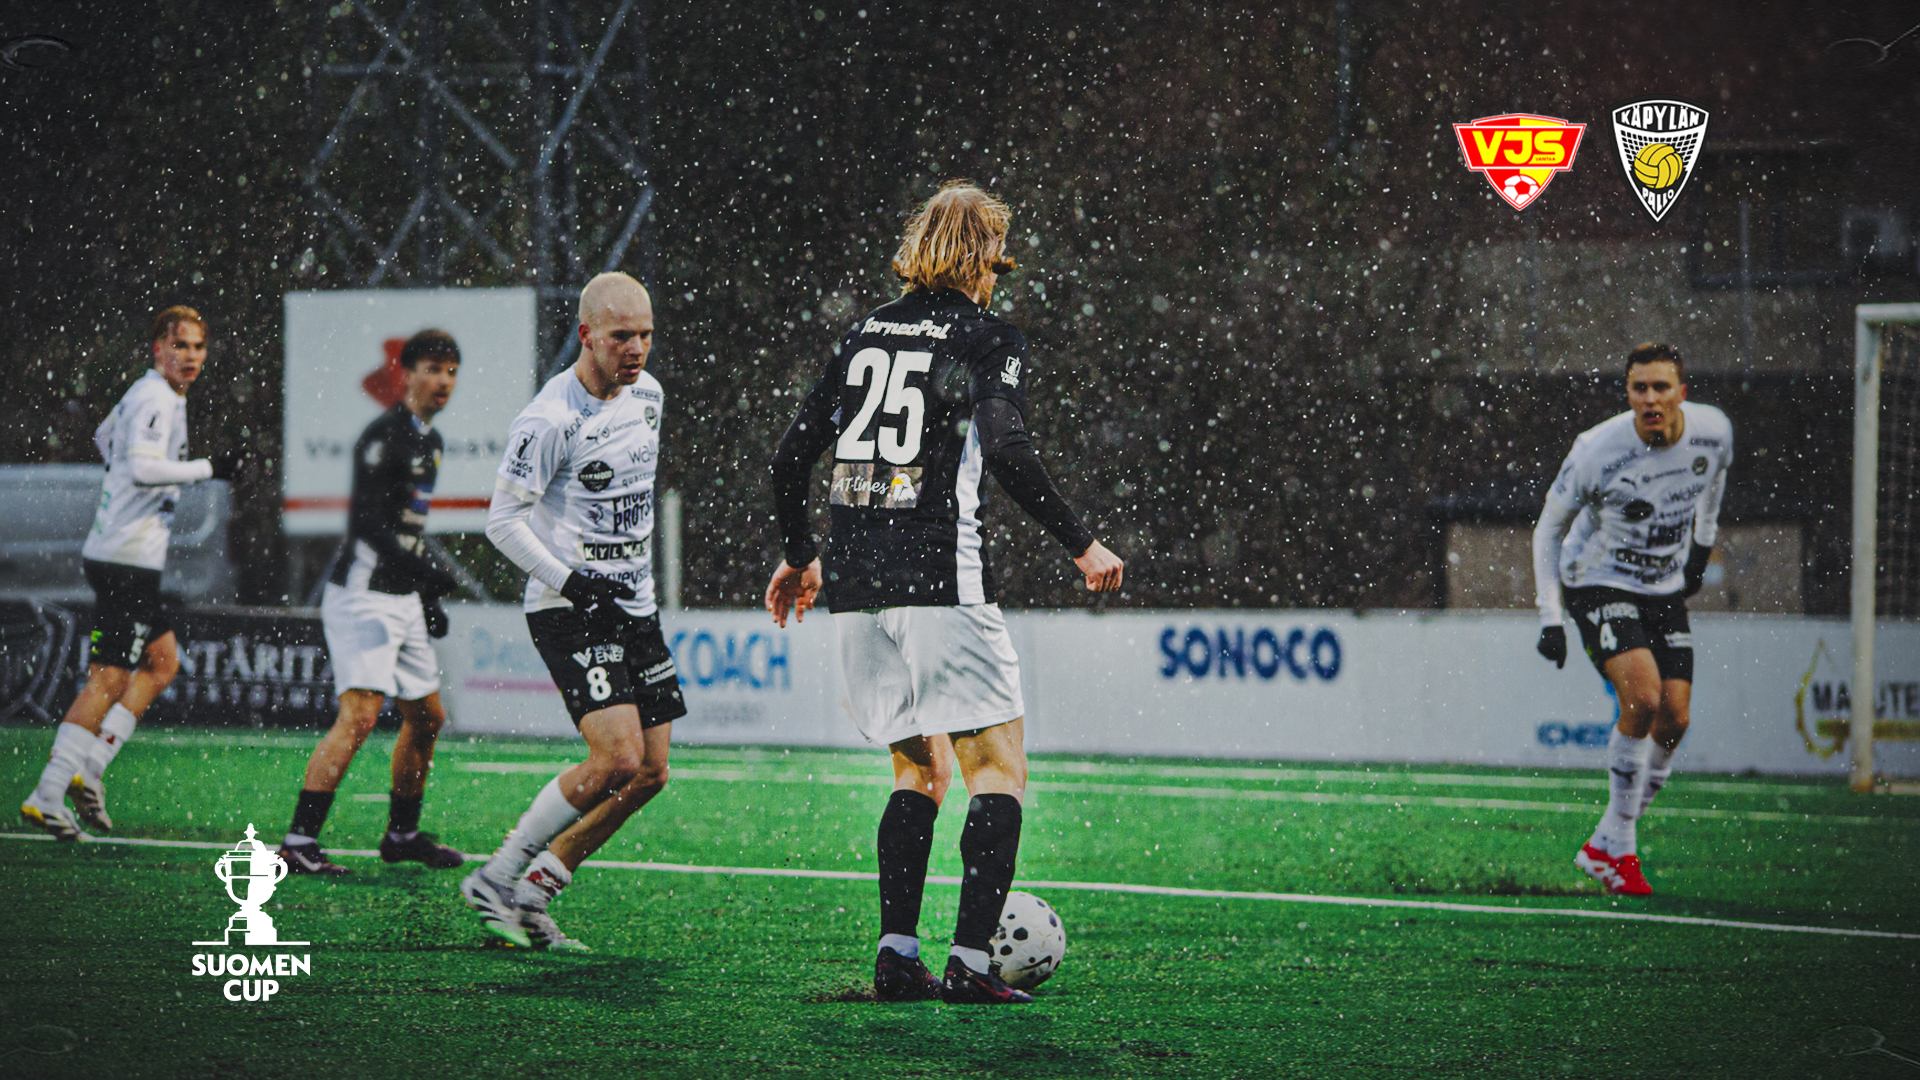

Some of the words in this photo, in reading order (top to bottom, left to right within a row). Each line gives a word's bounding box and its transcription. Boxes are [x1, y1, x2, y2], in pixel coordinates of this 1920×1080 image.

[860, 316, 951, 340] TorneoPal
[835, 347, 934, 465] 25
[1159, 626, 1342, 680] SONOCO
[1600, 621, 1618, 651] 4
[586, 666, 612, 702] 8
